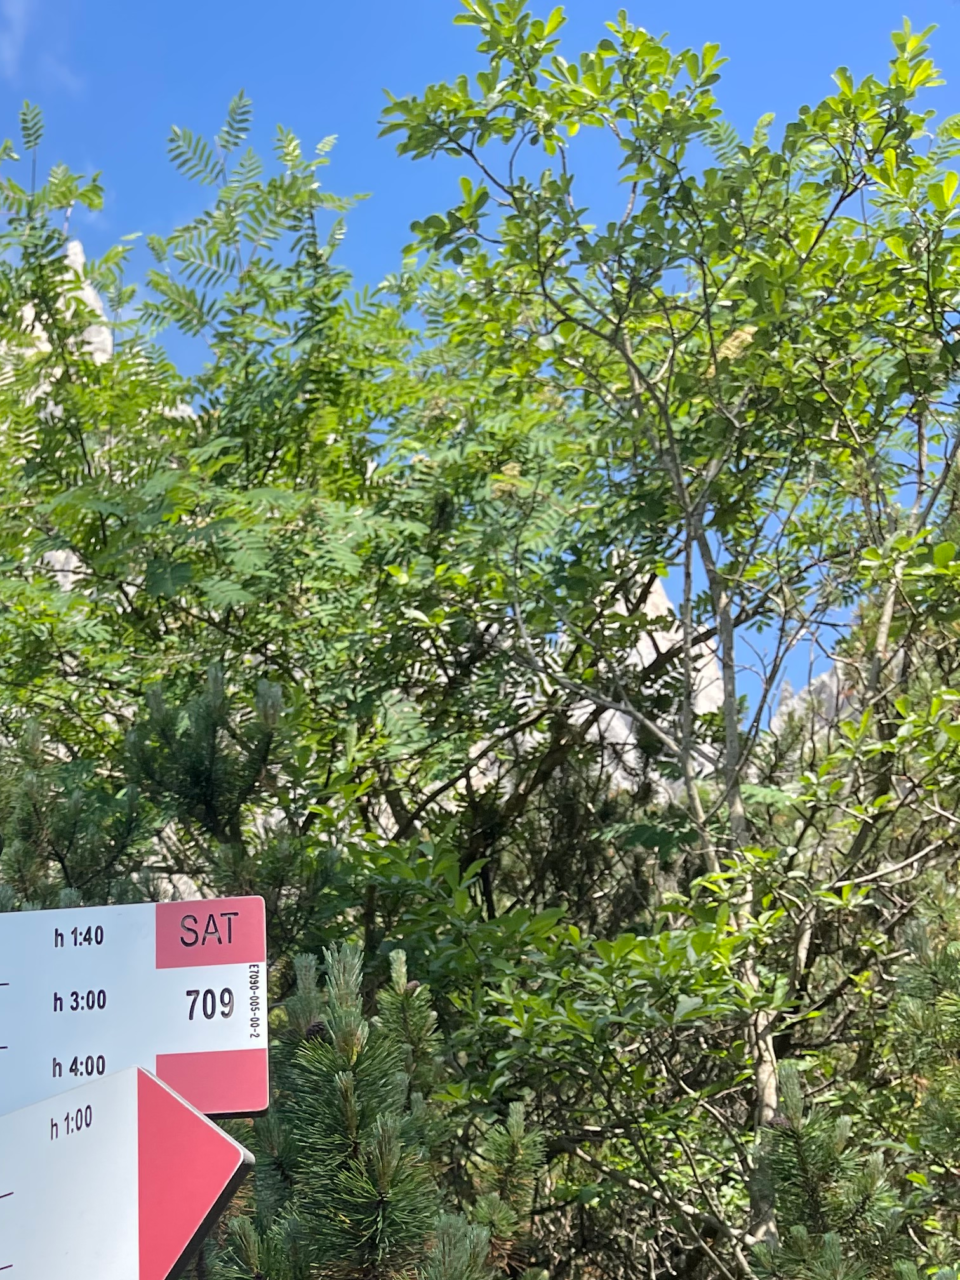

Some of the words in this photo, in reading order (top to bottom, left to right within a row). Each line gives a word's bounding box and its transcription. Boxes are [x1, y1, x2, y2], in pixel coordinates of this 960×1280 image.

[54, 928, 64, 948] h
[72, 925, 104, 947] 1:40
[180, 912, 239, 947] SAT
[53, 992, 63, 1013] h
[70, 989, 107, 1012] 3:00
[186, 987, 234, 1020] 709
[52, 1057, 62, 1078] h
[69, 1055, 106, 1077] 4:00
[50, 1119, 59, 1141] h
[64, 1104, 93, 1134] 1:00
